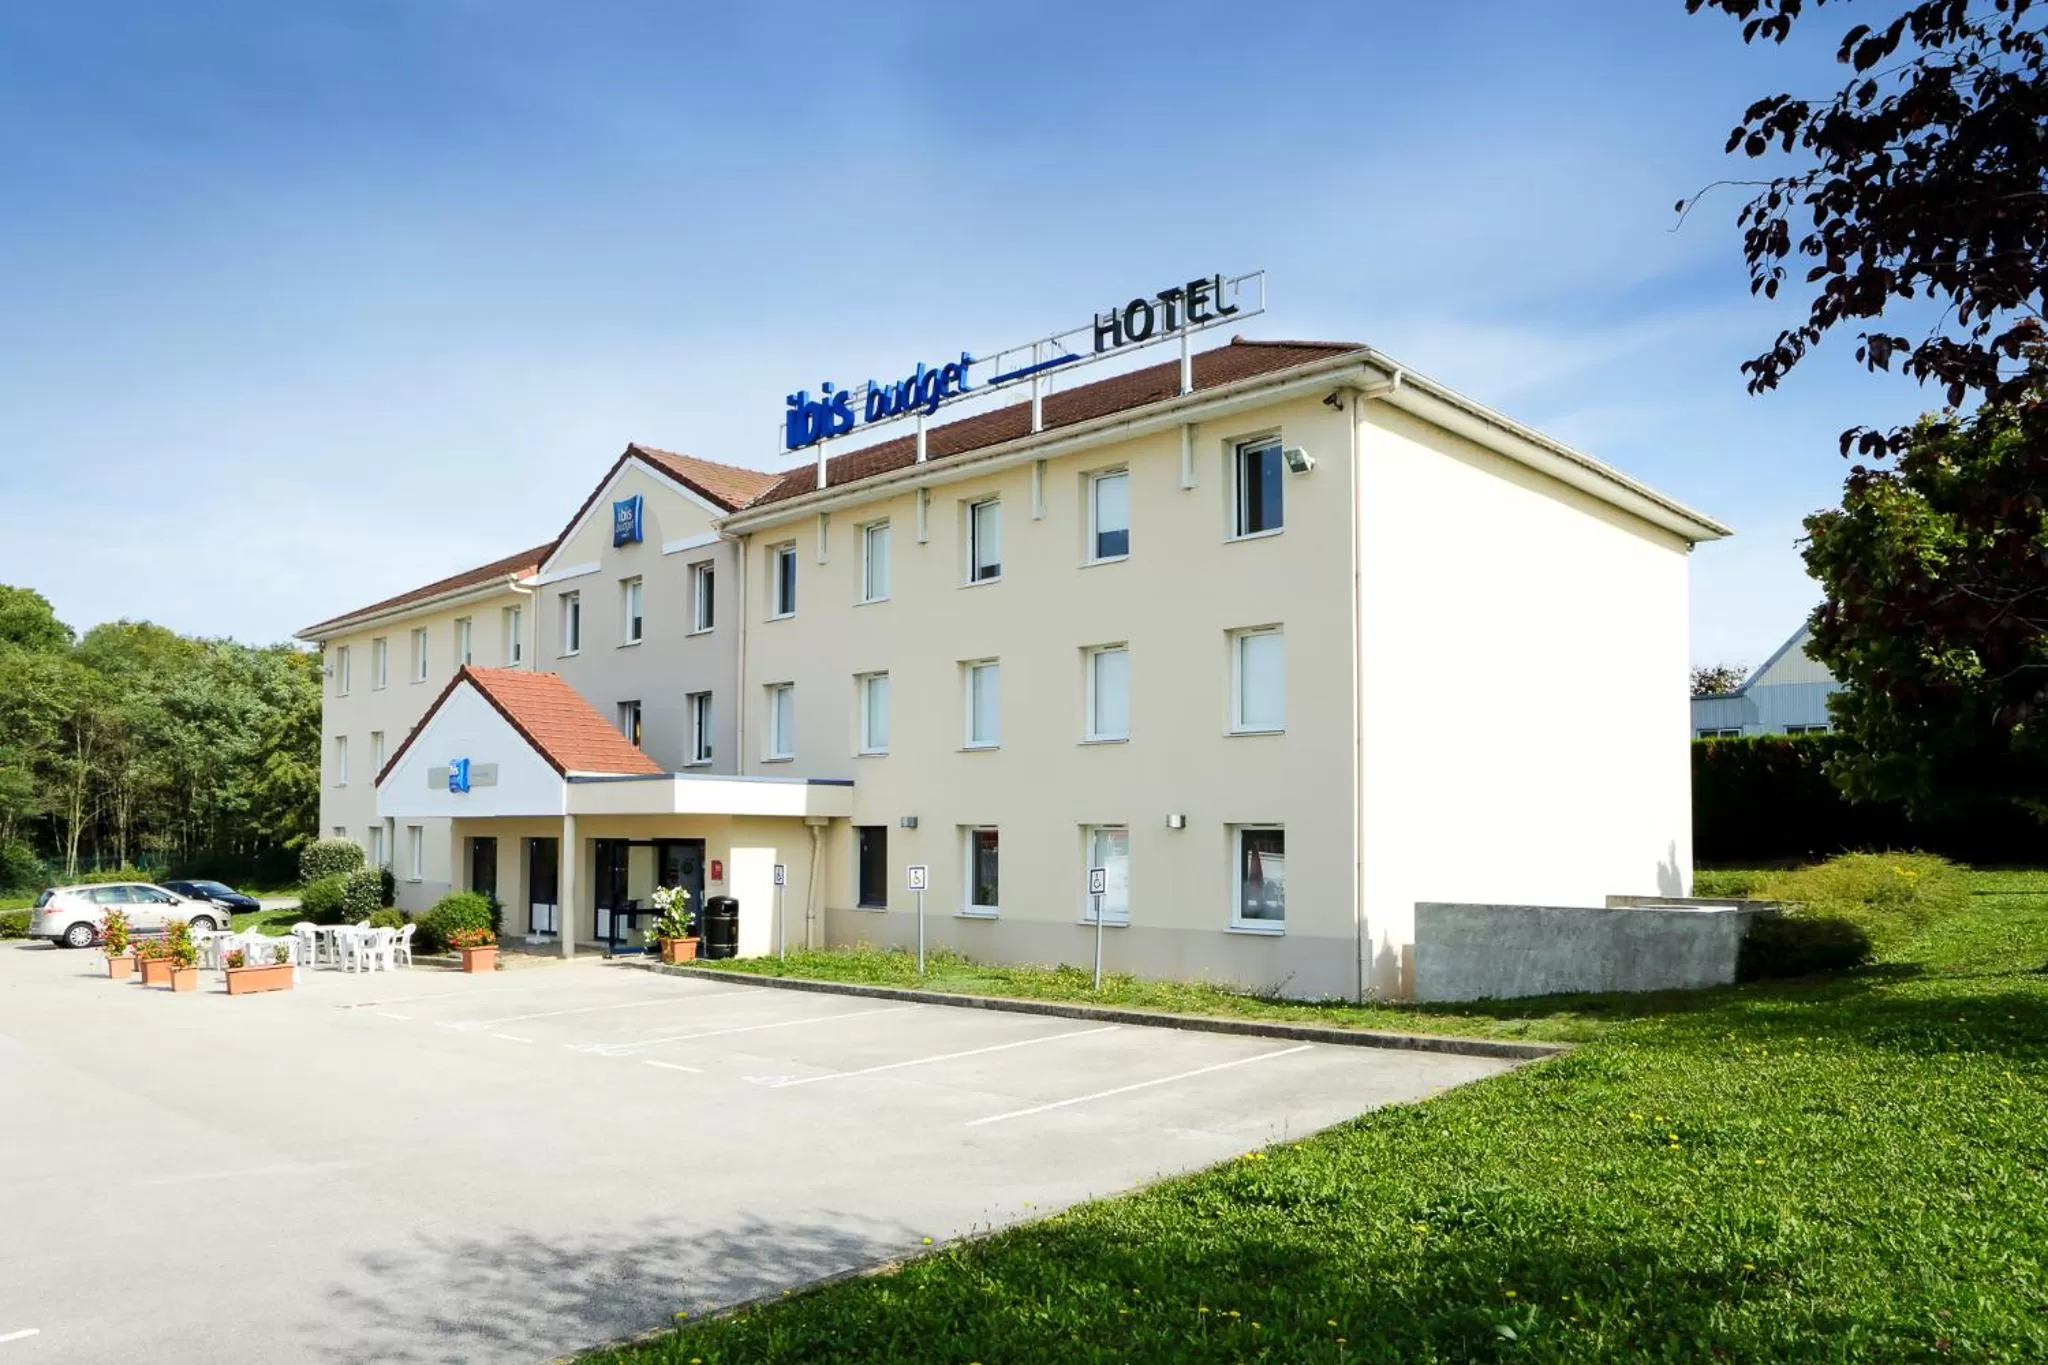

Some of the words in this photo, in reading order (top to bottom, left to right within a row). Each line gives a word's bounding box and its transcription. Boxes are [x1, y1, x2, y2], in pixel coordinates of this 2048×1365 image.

[786, 382, 855, 449] ibis
[864, 352, 974, 423] budget
[1094, 274, 1238, 353] HOTEL
